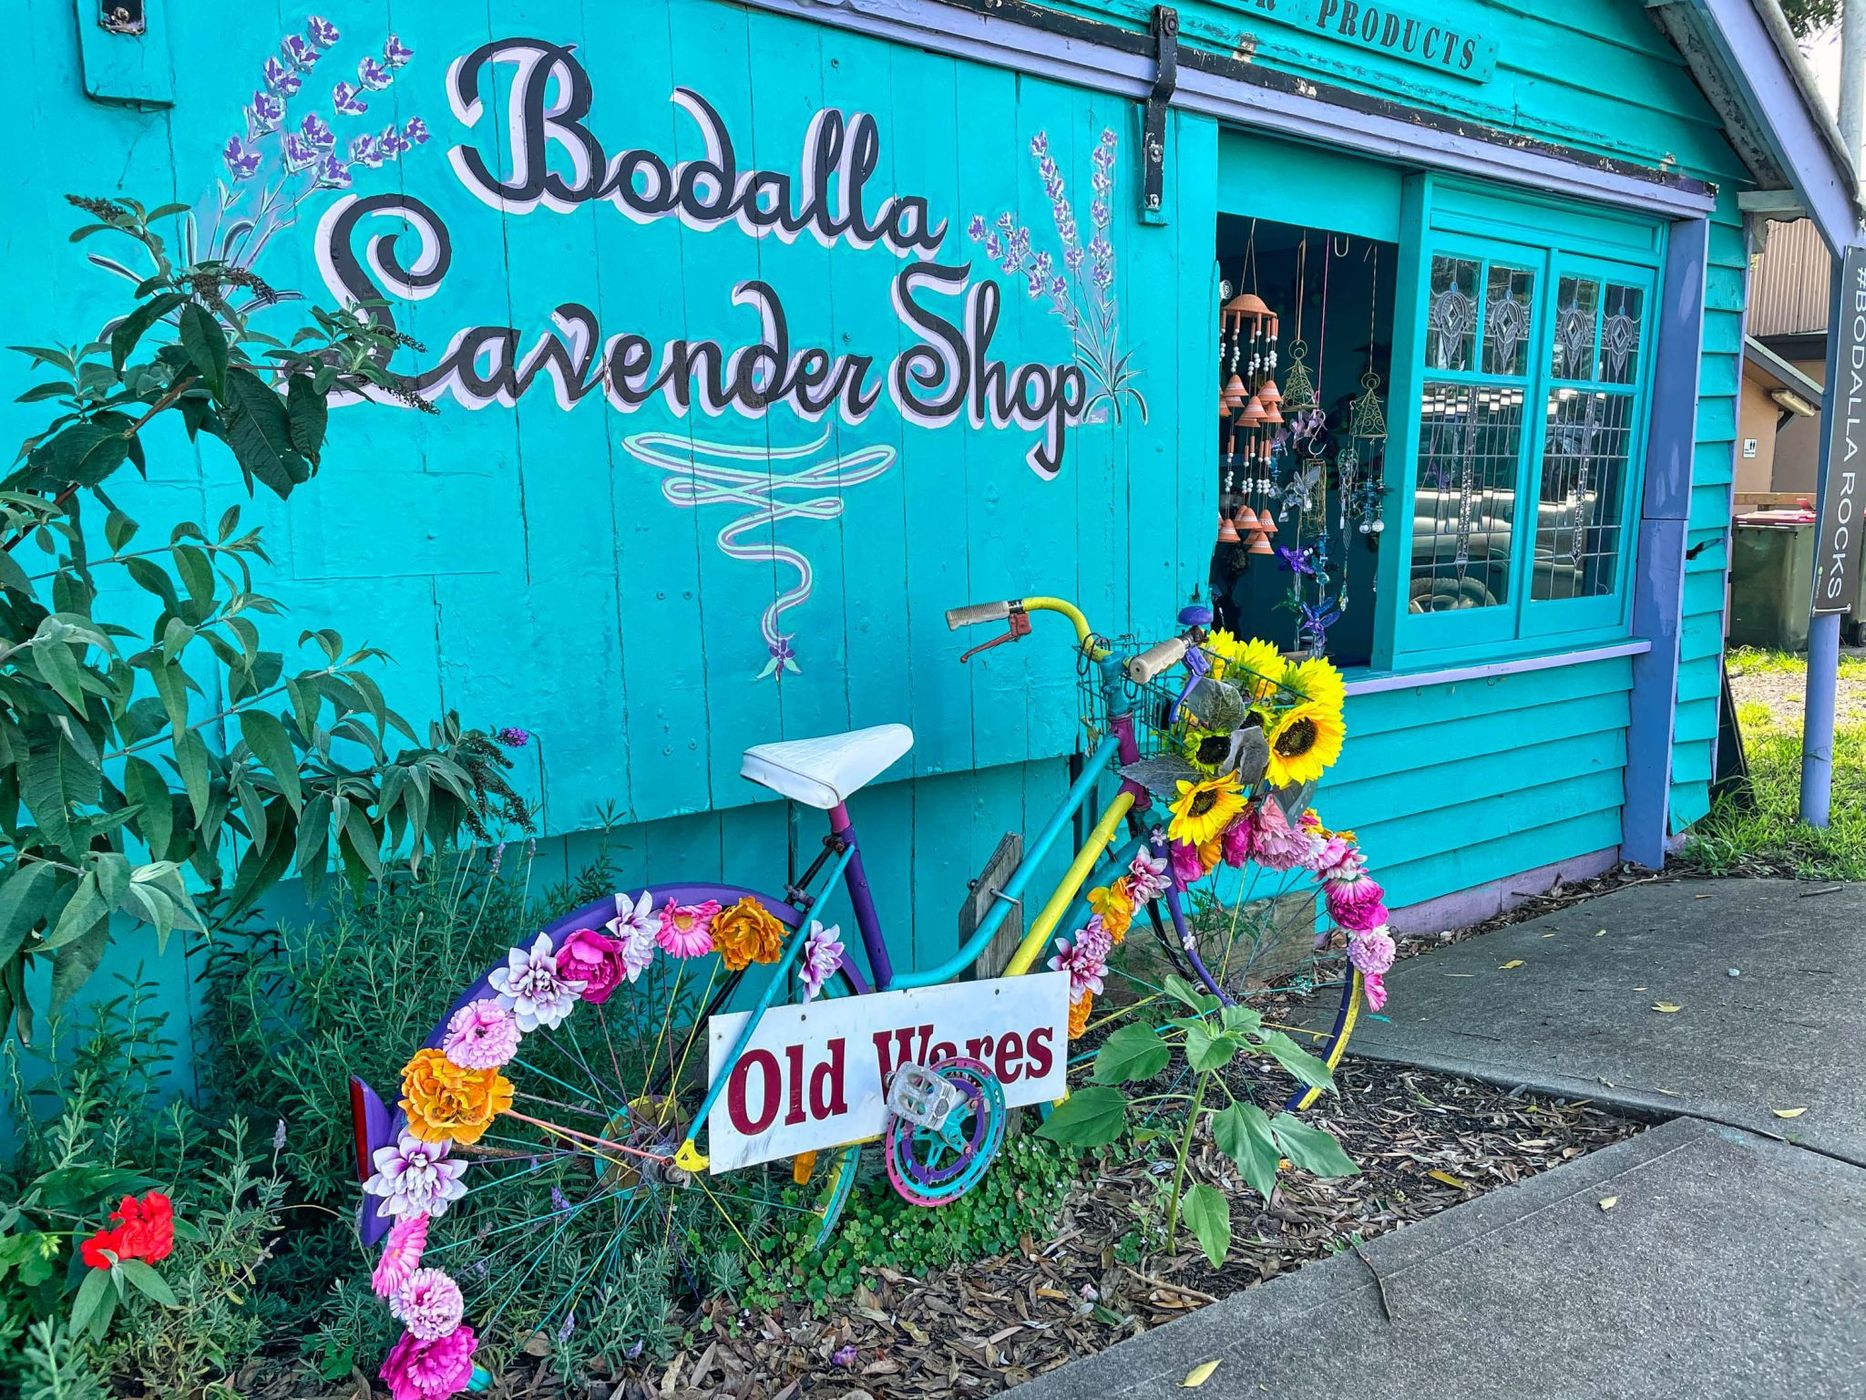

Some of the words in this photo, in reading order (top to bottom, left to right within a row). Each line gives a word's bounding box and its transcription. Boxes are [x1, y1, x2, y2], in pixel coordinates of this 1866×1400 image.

[1315, 0, 1477, 71] PRODUCTS
[447, 38, 946, 259] Bodalla
[278, 193, 880, 427] Lavender
[893, 261, 1087, 482] Shop
[1827, 471, 1857, 599] ROCKS
[727, 1037, 848, 1136] Old
